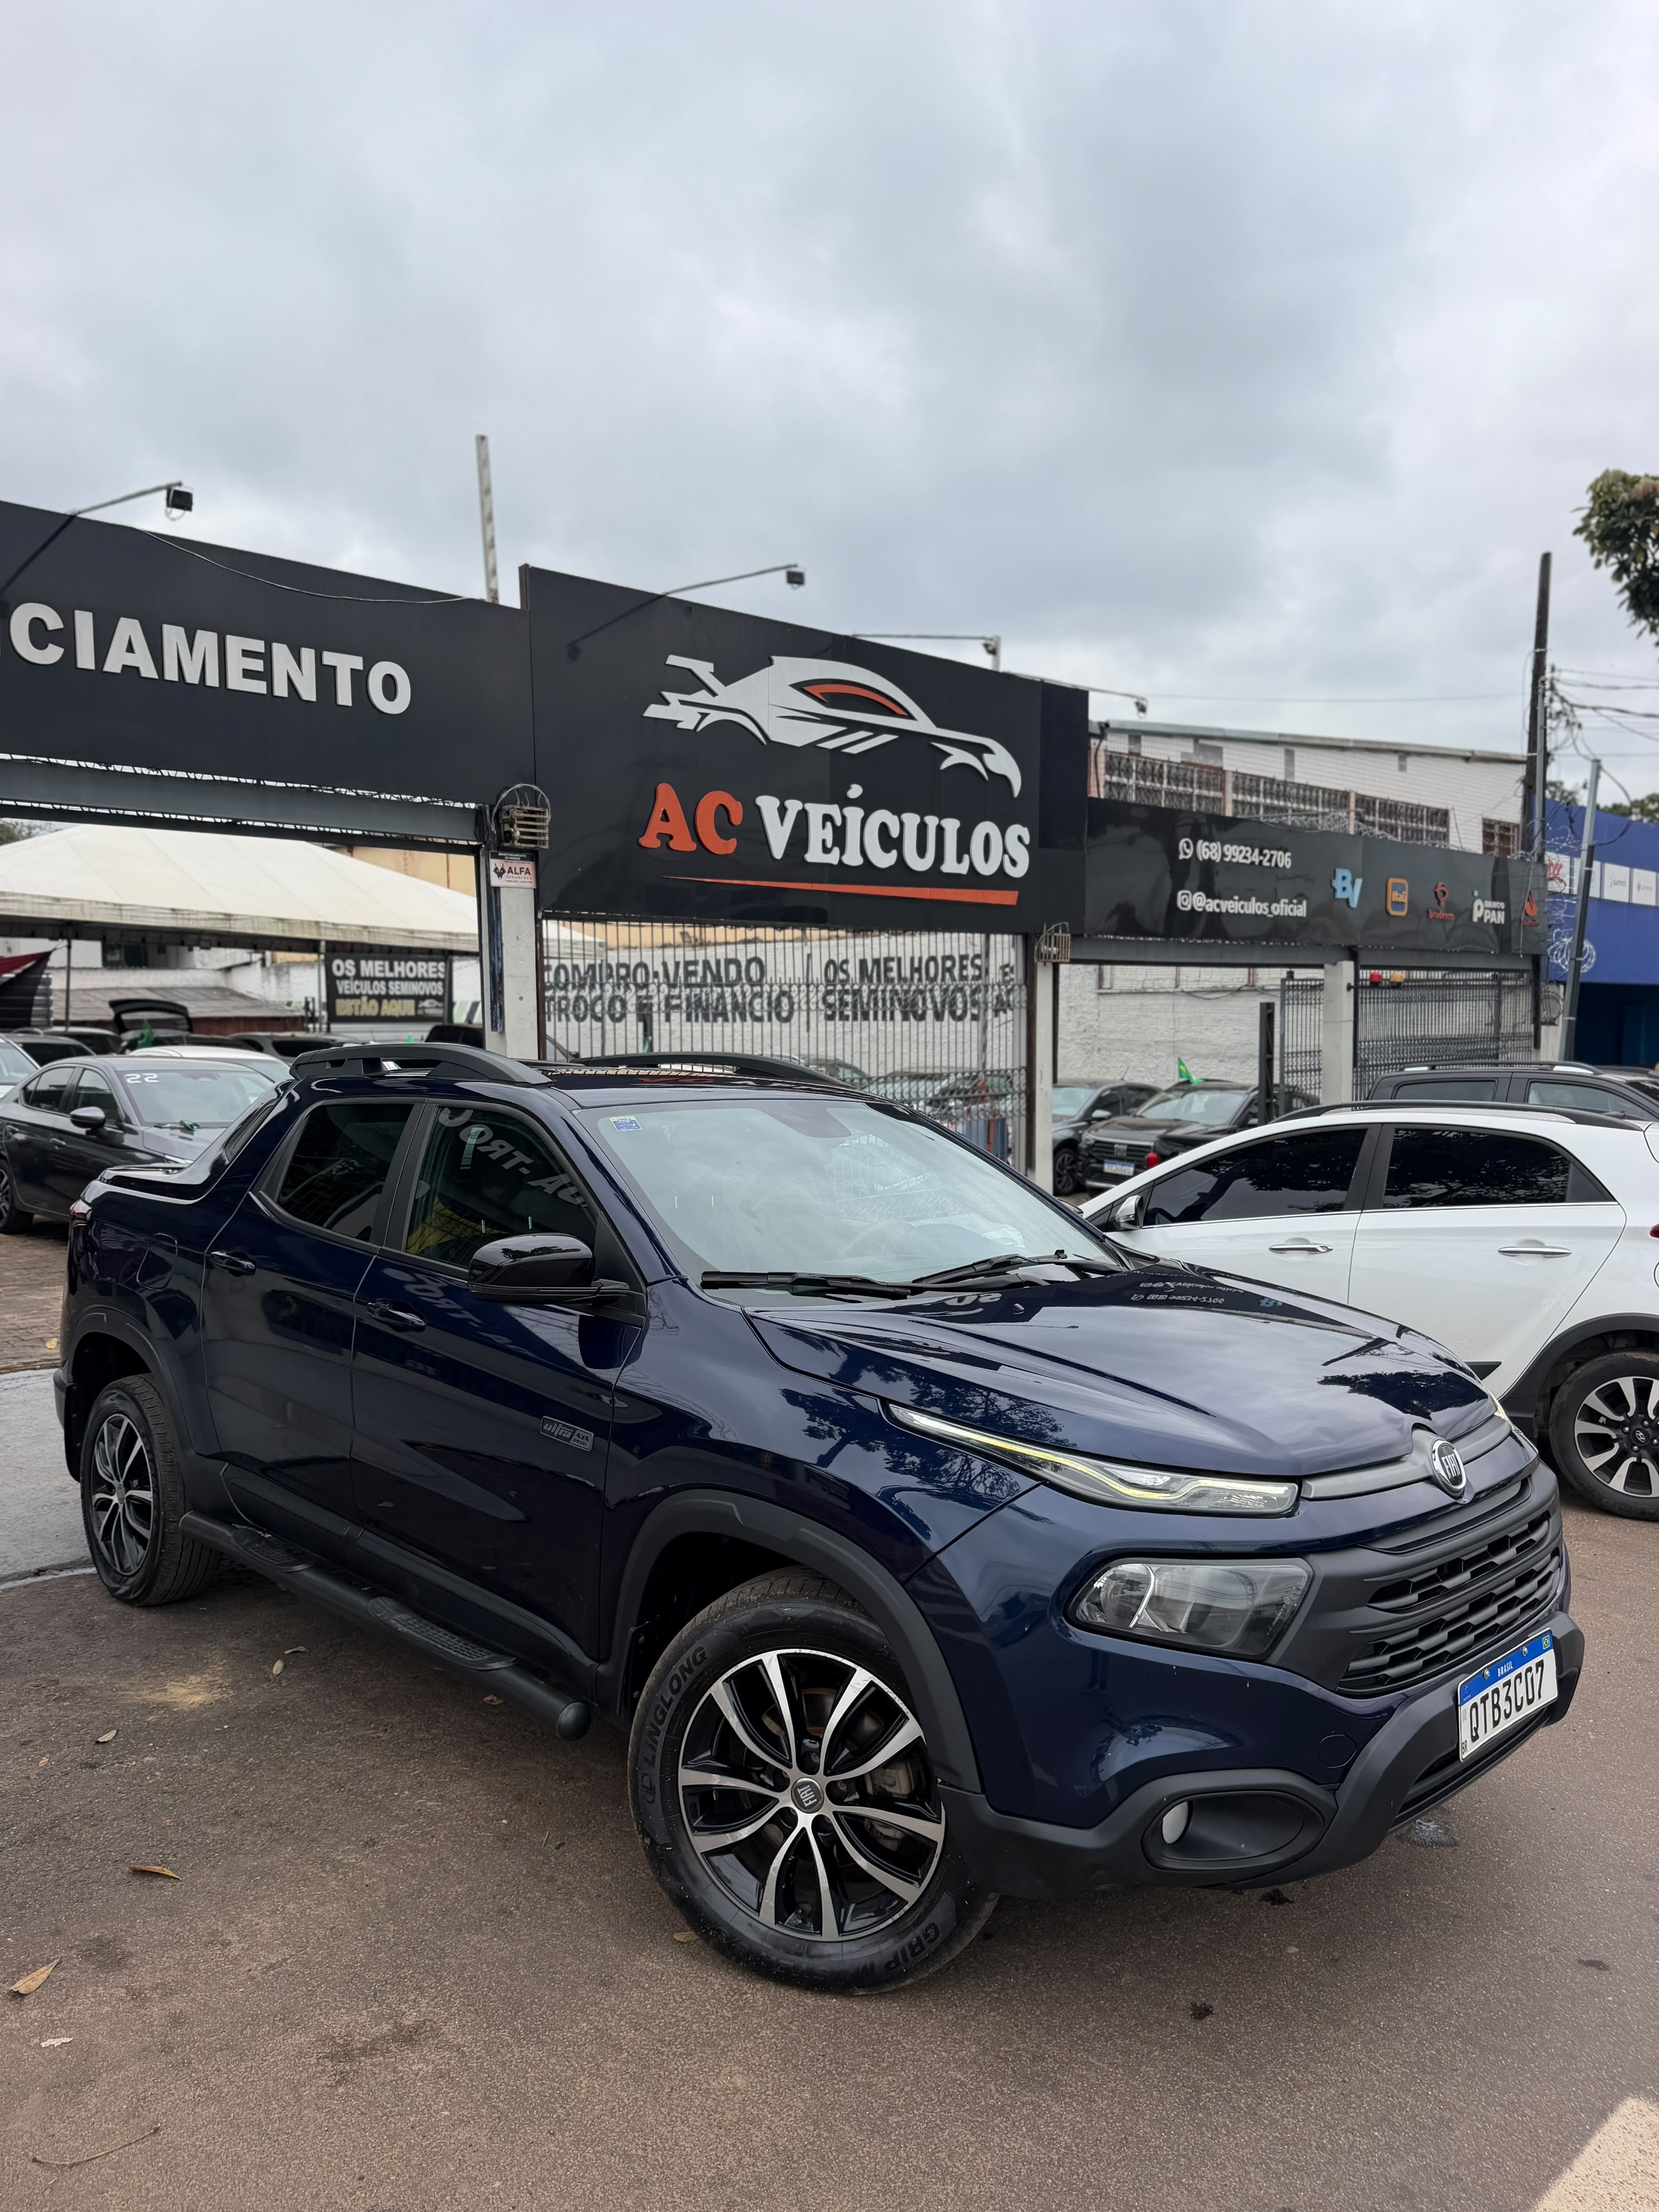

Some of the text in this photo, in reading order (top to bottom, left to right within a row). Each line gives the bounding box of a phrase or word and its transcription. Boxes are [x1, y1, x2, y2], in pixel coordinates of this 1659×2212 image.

[9, 602, 412, 715] CIAMENTO
[639, 782, 1030, 878] AC VEÍCULOS
[1196, 840, 1292, 868] (68) 99234-2706
[507, 866, 531, 876] ALFA
[1332, 868, 1363, 908] BV
[1391, 891, 1406, 902] Itaú
[1192, 892, 1306, 917] @acveiculos_oficial
[1484, 909, 1505, 924] PAN
[332, 959, 446, 978] OS MELHORES
[824, 958, 850, 984] OS
[858, 953, 982, 984] MELHORES
[336, 977, 443, 995] VEÍCULOS SEMINOVOS
[336, 995, 379, 1016] ESTÃO
[124, 1073, 160, 1084] 22
[573, 1438, 588, 1447] DIESEL
[1441, 1453, 1461, 1479] FIAT
[1497, 1661, 1513, 1677] BRASIL
[643, 1646, 707, 1769] LINGLONG
[1469, 1658, 1544, 1743] QTB3C07
[797, 1784, 817, 1807] FIAT
[885, 1922, 940, 1974] GRIP
